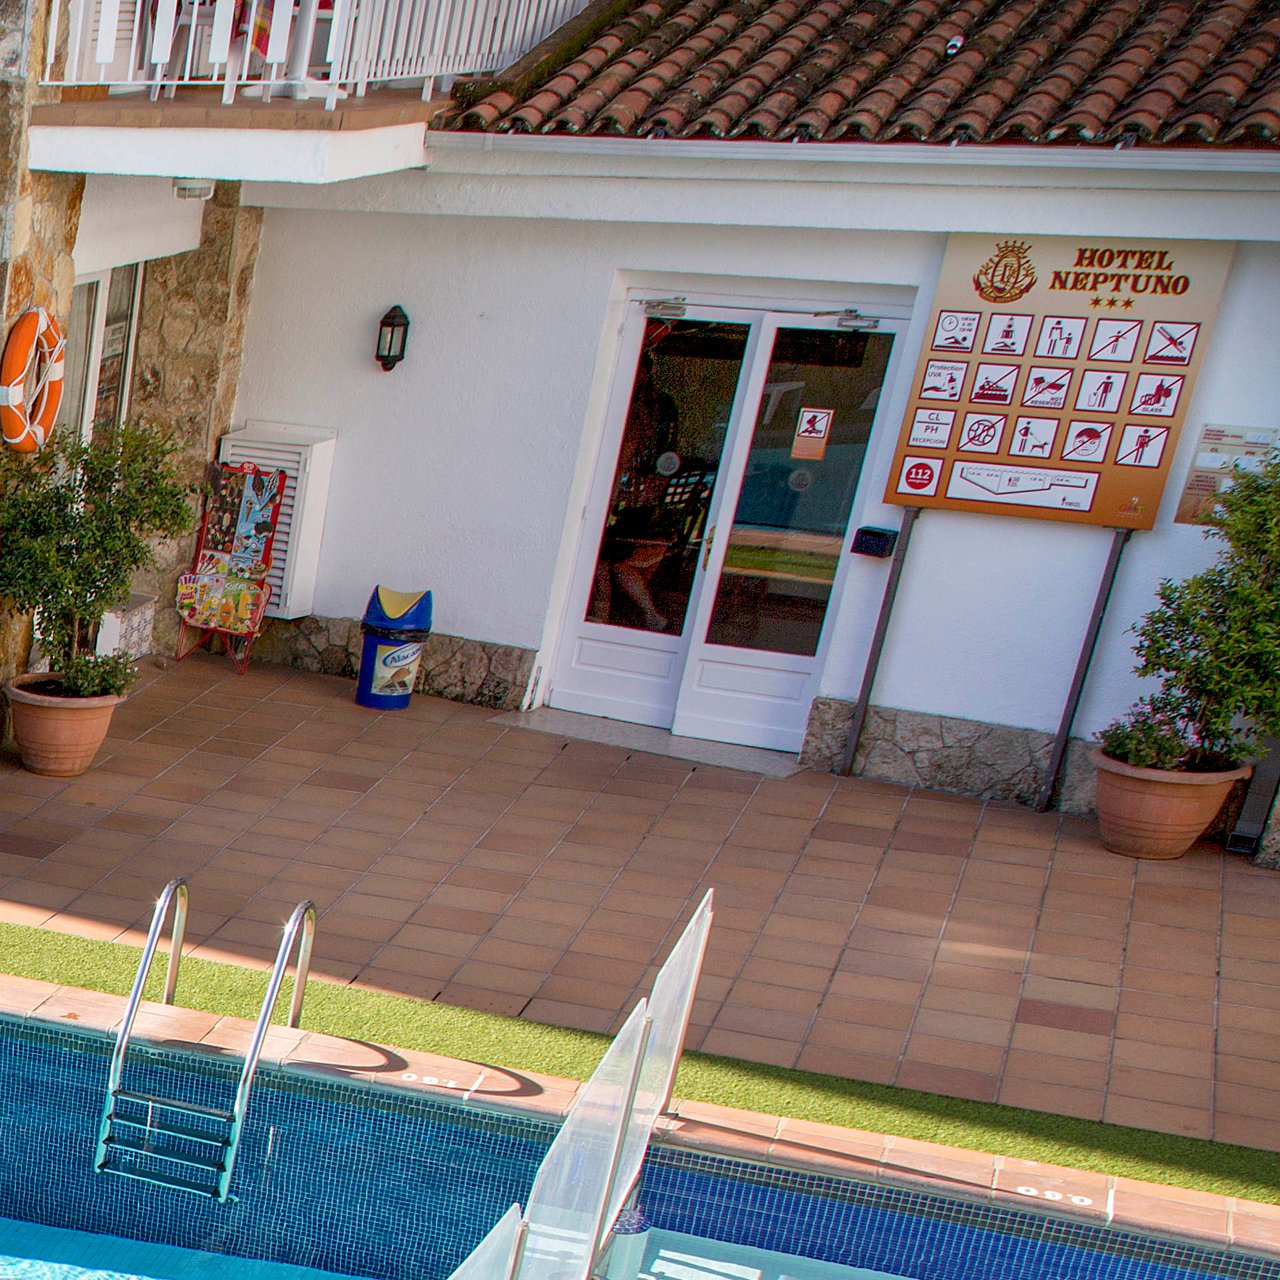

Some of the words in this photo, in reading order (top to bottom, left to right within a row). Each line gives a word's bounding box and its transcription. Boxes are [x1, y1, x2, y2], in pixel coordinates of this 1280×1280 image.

[1073, 247, 1175, 271] HOTEL
[1048, 270, 1191, 296] NEPTUNO
[927, 412, 941, 421] CL
[924, 425, 938, 434] PH
[909, 468, 931, 480] 112
